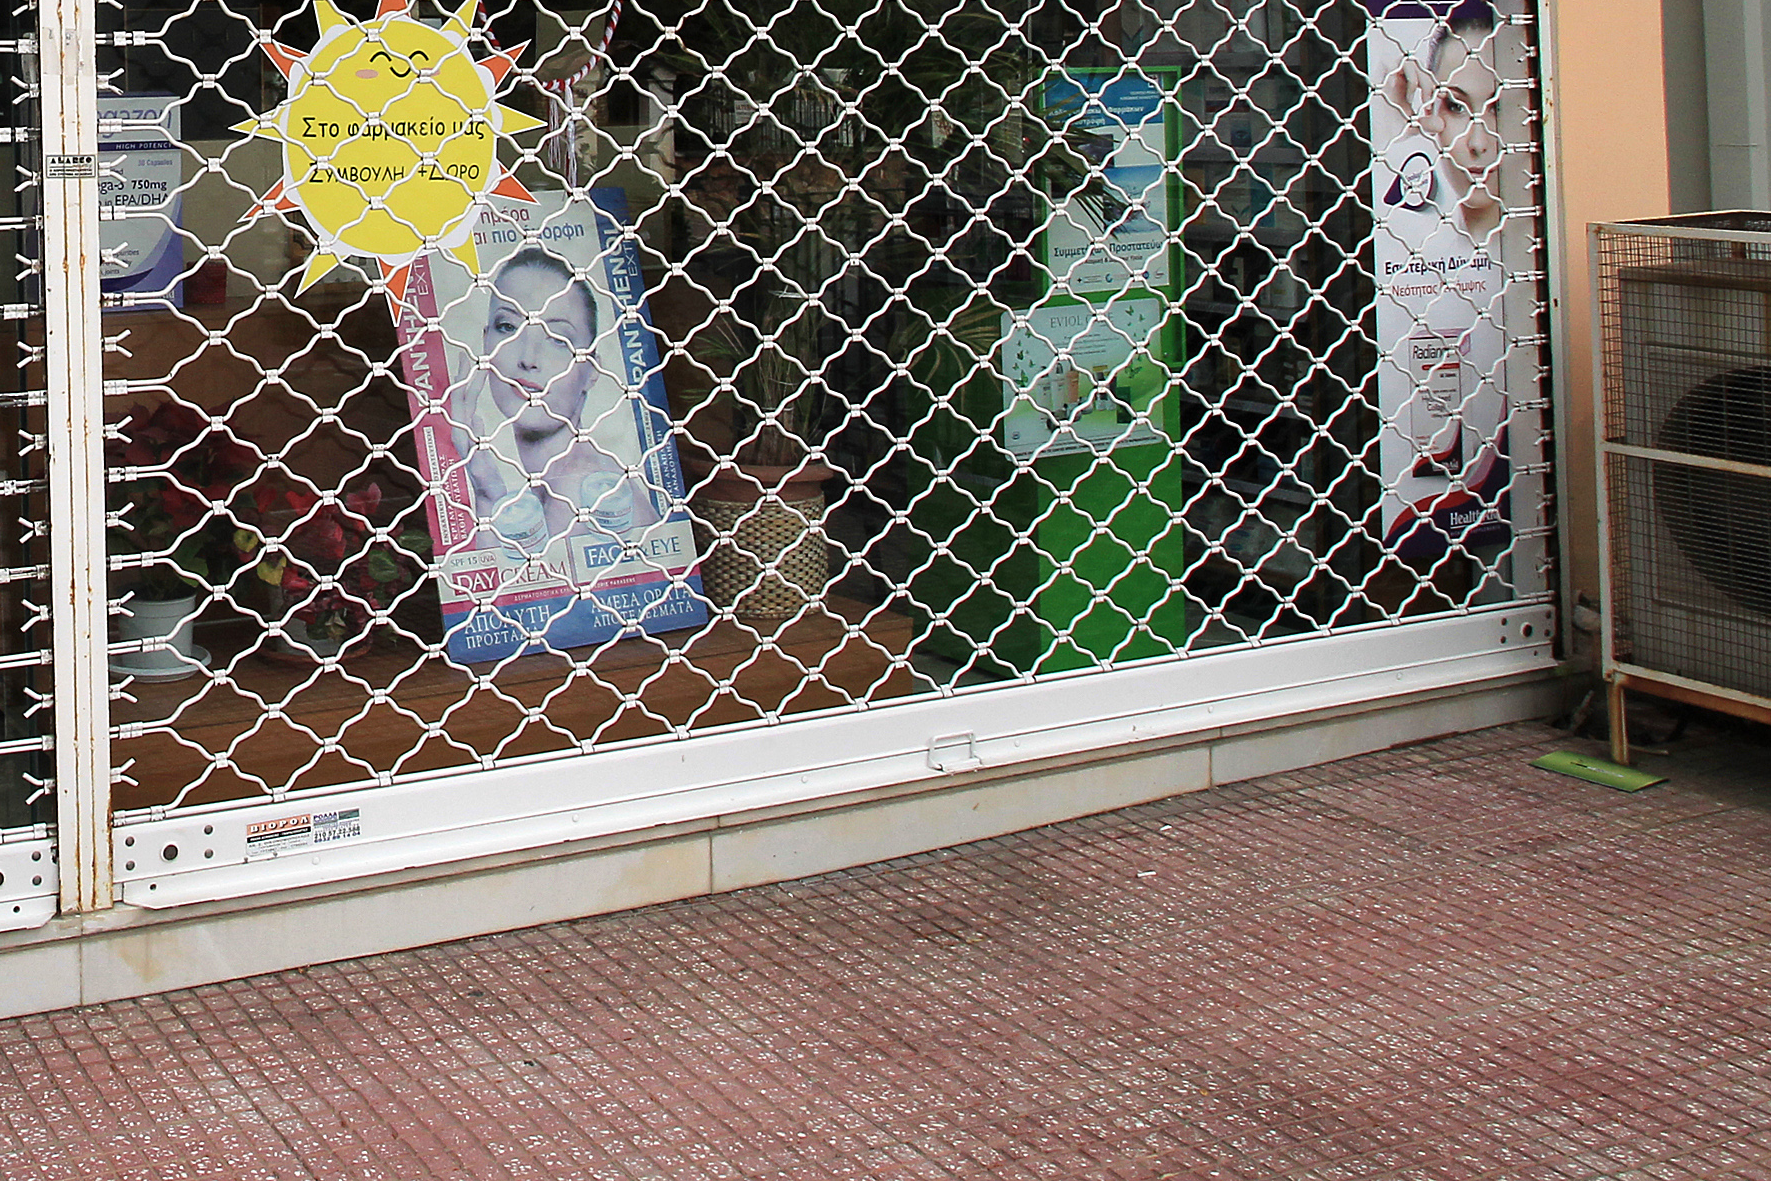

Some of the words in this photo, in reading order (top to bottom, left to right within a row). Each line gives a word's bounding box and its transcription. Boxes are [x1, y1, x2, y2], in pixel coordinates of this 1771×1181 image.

[302, 116, 339, 139] Στο
[131, 179, 167, 193] 750mg
[1391, 283, 1438, 299] Νεότητας
[1050, 315, 1082, 328] EVIOL
[650, 536, 681, 556] EYE
[468, 556, 478, 565] 15
[481, 554, 496, 564] UVA
[456, 570, 497, 594] DAY
